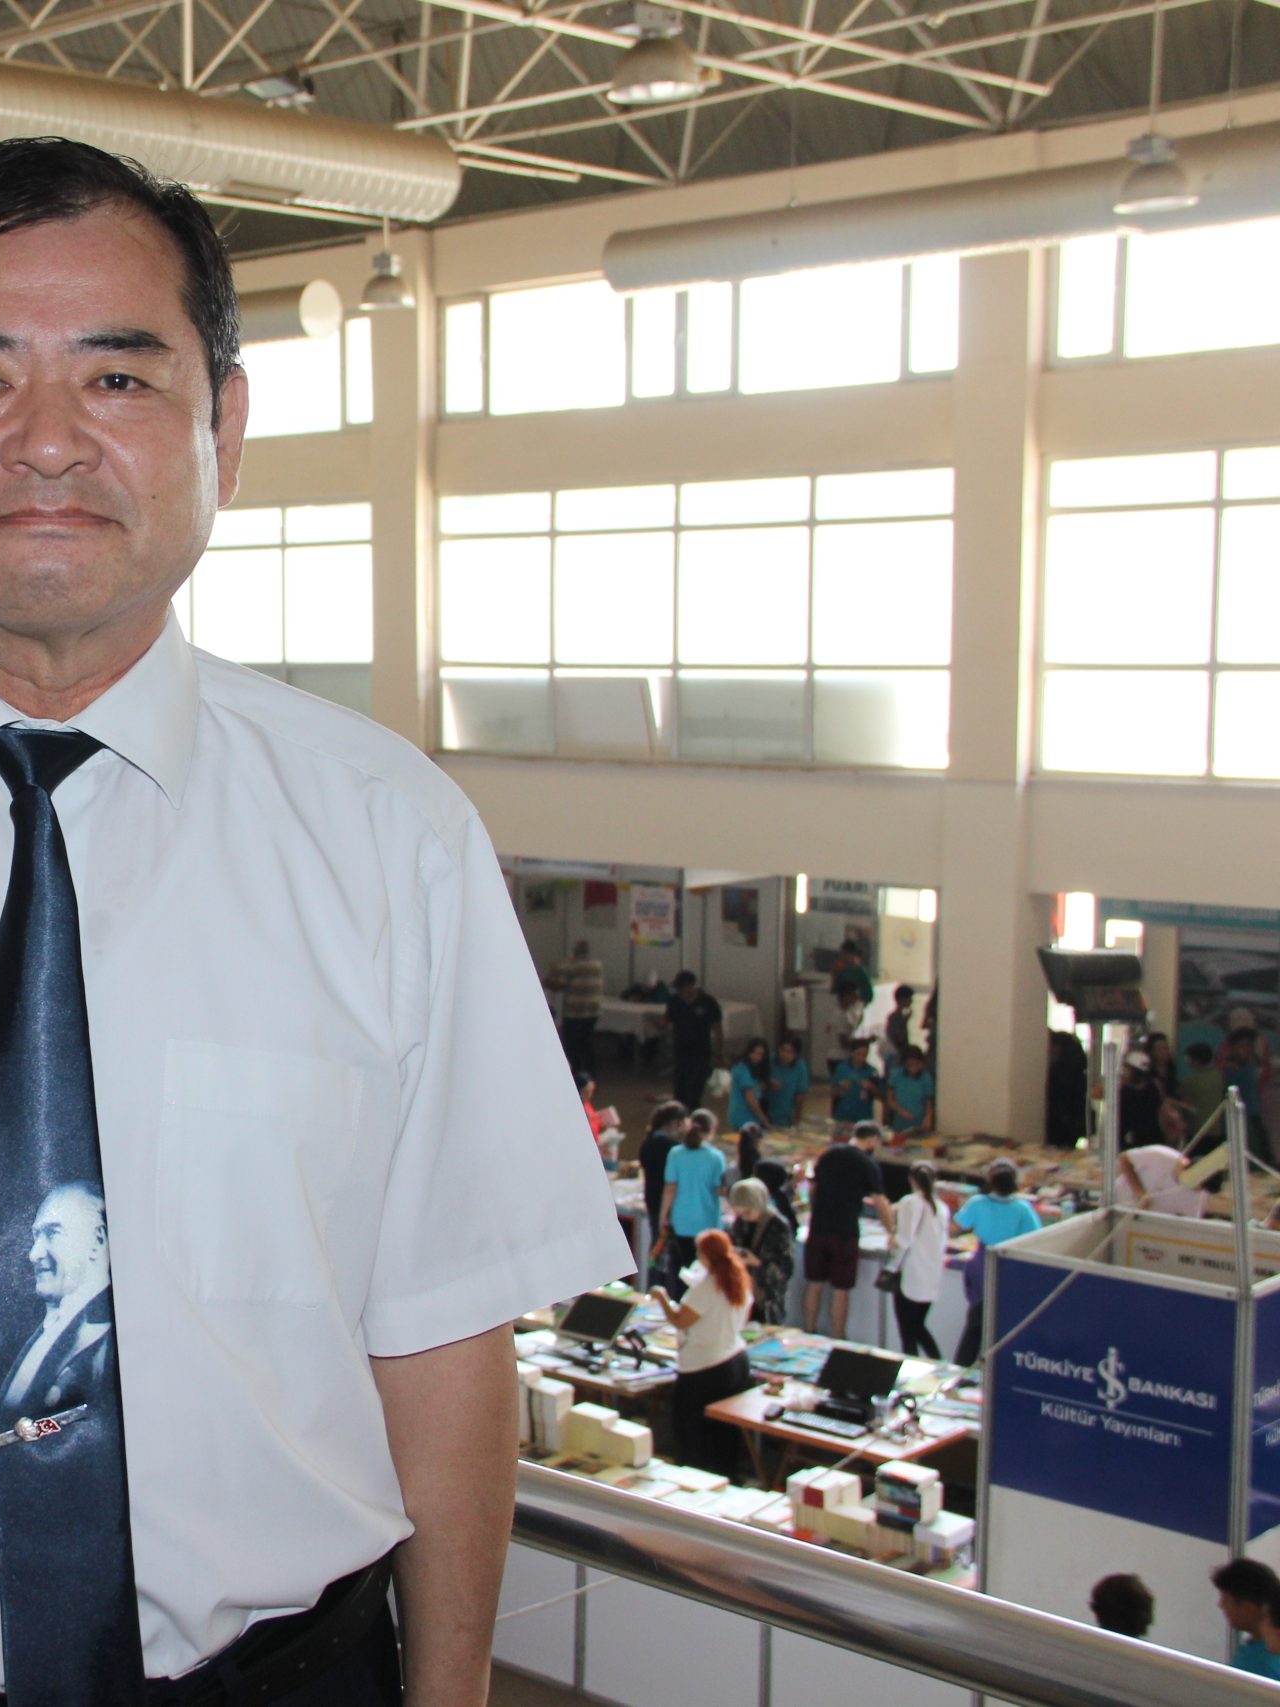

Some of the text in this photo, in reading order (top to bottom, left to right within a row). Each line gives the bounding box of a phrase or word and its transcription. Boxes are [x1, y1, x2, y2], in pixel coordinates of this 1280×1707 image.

[1012, 1351, 1096, 1384] TÜRKİYE
[1127, 1376, 1217, 1409] BANKASI
[1040, 1401, 1181, 1448] Kültür Yayınları
